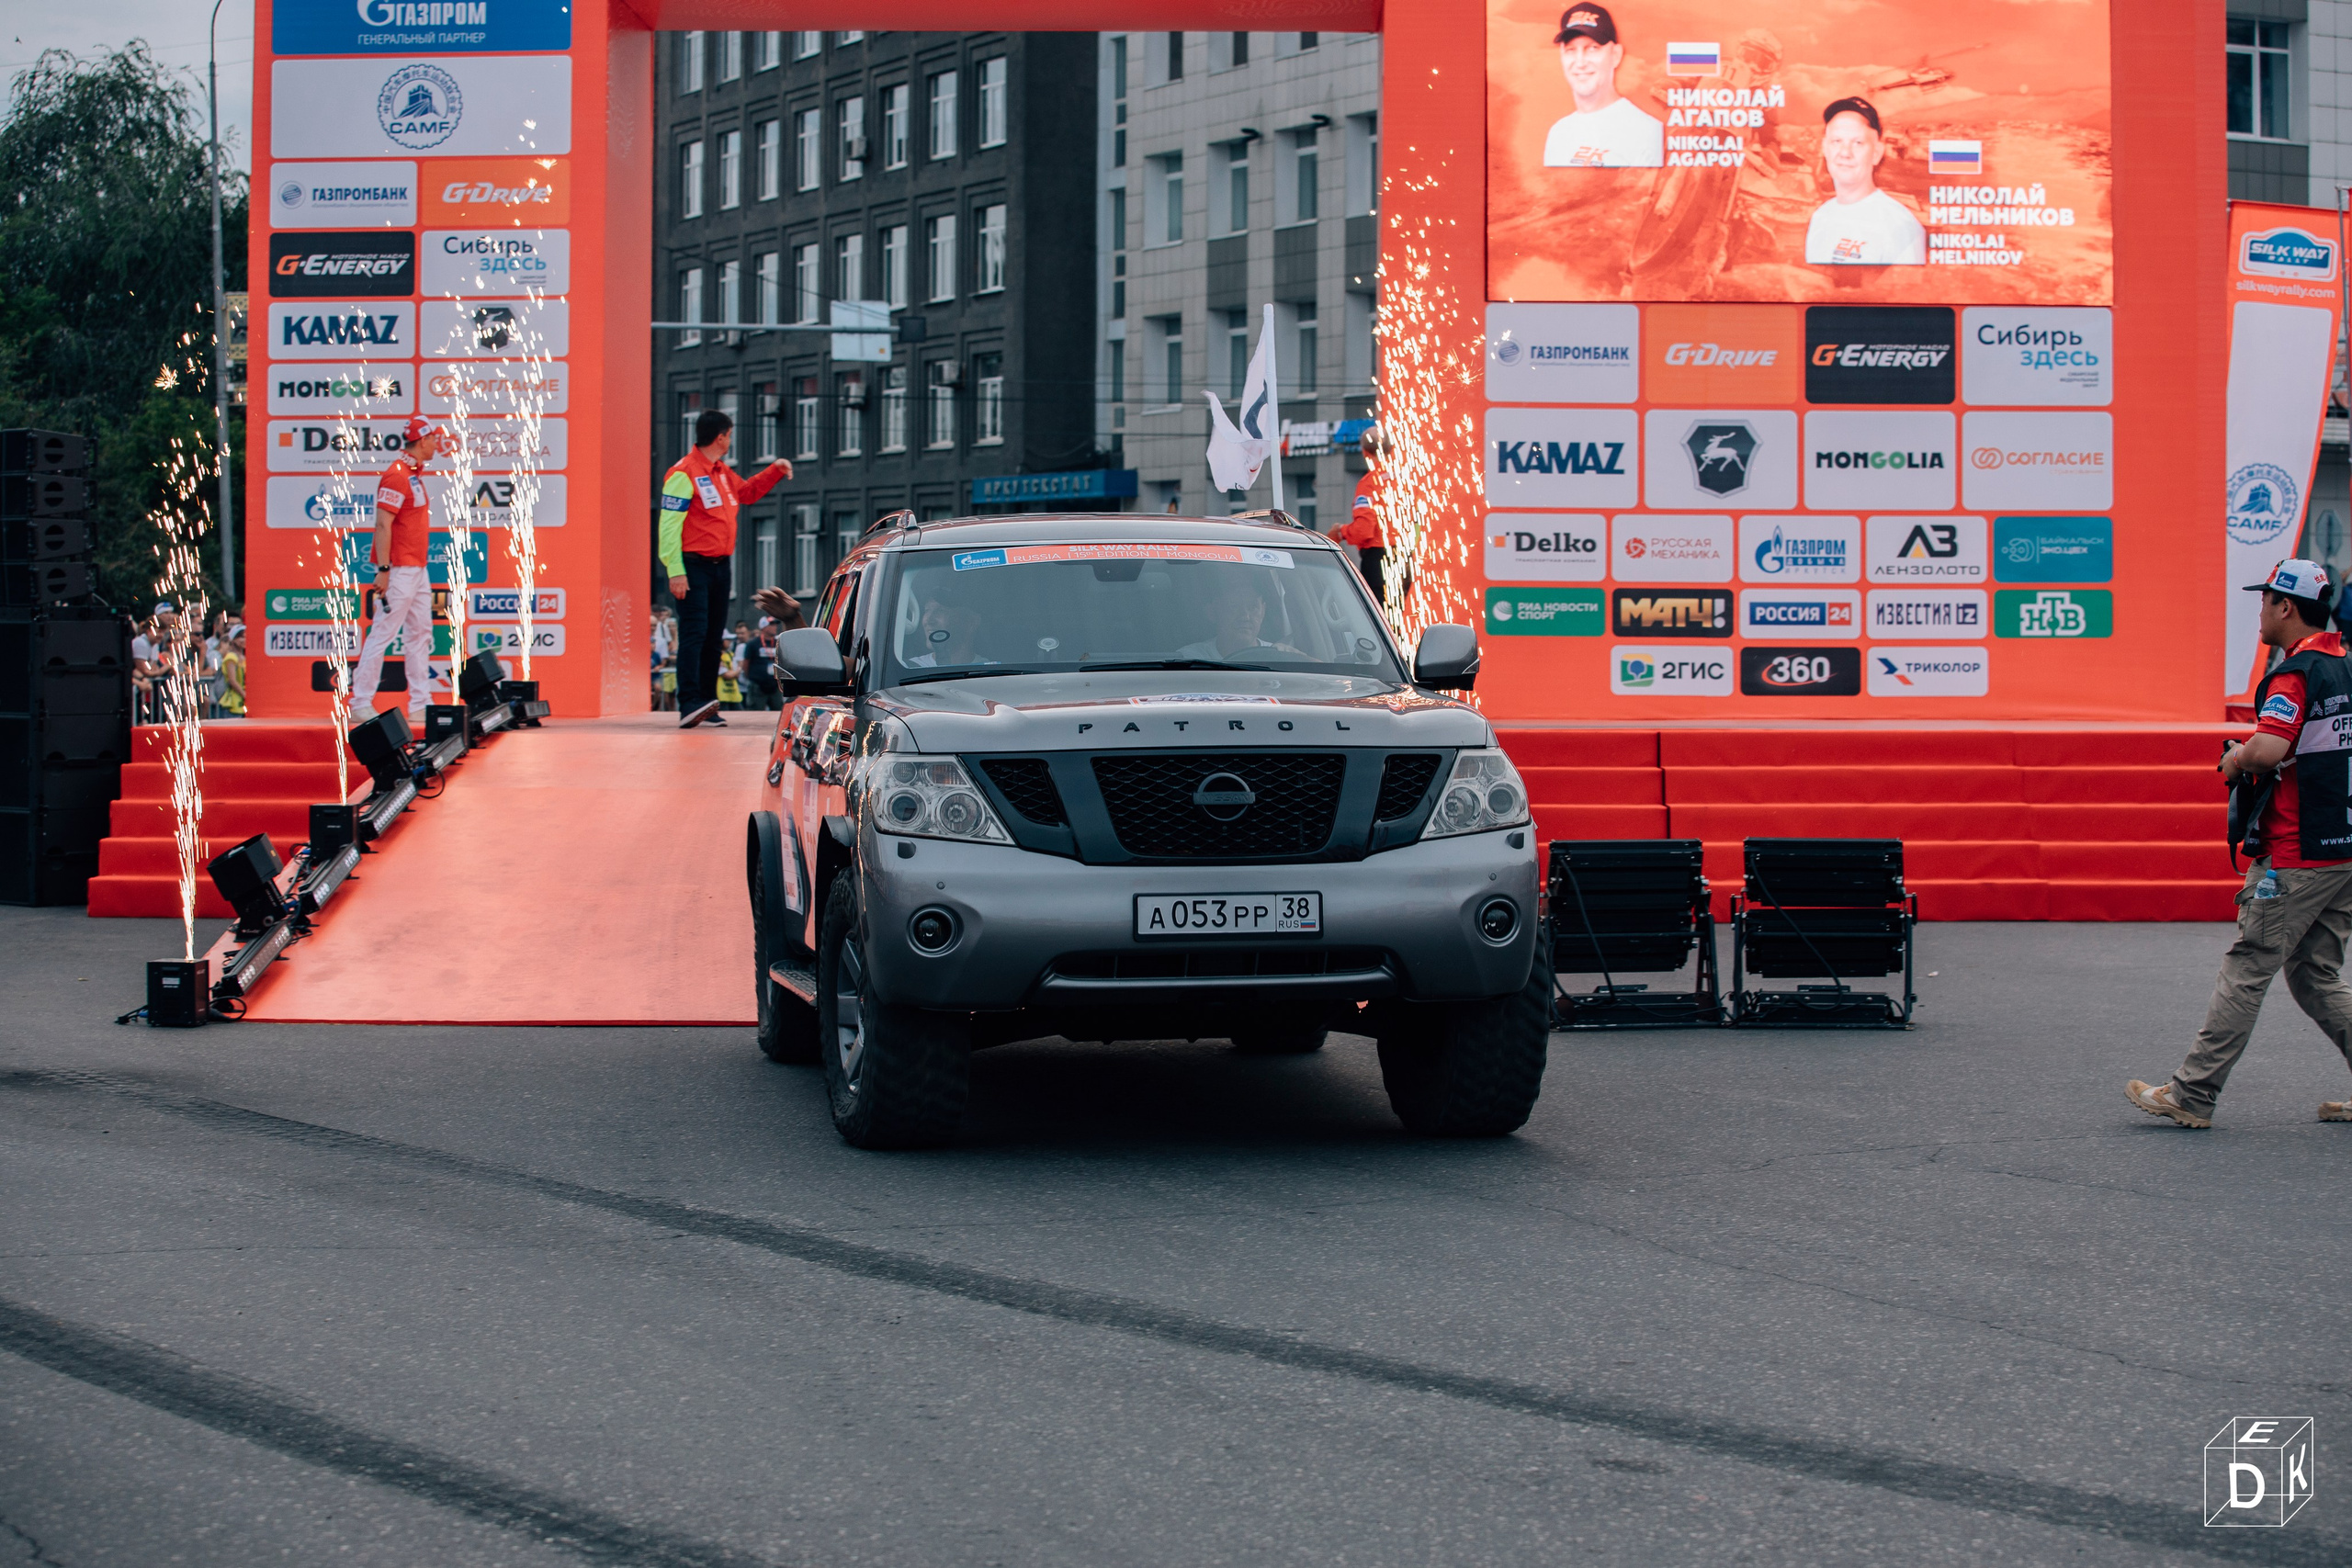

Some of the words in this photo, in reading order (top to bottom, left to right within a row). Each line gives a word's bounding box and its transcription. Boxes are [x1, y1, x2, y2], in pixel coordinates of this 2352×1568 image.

[396, 2, 487, 26] ГАЗПРОМ
[357, 32, 436, 45] ГЕНЕРАЛЬНЫЙ
[438, 32, 487, 44] ПАРТНЕР
[1667, 85, 1785, 108] НИКОЛАЙ
[1667, 108, 1765, 128] АГАПОВ
[390, 121, 450, 134] CAMF
[1667, 135, 1743, 152] NIKOLAI
[1667, 152, 1745, 167] AGAPOV
[312, 186, 408, 201] ГАЗПРОМБАНК
[1929, 183, 2045, 206] НИКОЛАЙ
[1929, 207, 2075, 227] МЕЛЬНИКОВ
[444, 236, 533, 258] Сибирь
[1929, 233, 2005, 249] NIKOLAI
[1929, 249, 2023, 265] MELNIKOV
[2249, 243, 2290, 256] SILK
[2292, 247, 2329, 260] WAY
[480, 257, 547, 275] здесь
[2235, 279, 2335, 299] silkwayrally.com
[283, 315, 400, 345] KAMAZ
[1977, 323, 2083, 351] Сибирь
[1530, 345, 1630, 360] ГАЗПРОМБАНК
[2020, 350, 2099, 370] здесь
[278, 380, 402, 398] MONGOLA
[462, 378, 560, 393] СОГЛАСИЕ
[467, 432, 539, 443] РУССК
[1498, 441, 1625, 475] KAMAZ
[1815, 451, 1945, 469] MONGOLIA
[2006, 451, 2105, 466] СОГЛАСИЕ
[2226, 515, 2282, 531] CAMF
[1514, 532, 1597, 553] Delko
[1651, 537, 1712, 548] РУССКАЯ
[1785, 539, 1846, 555] ГАЗПРОМ
[1012, 553, 1061, 563] RUSSIA
[1167, 551, 1238, 561] MONGOLIA
[1651, 549, 1721, 559] МЕХАНИКА
[1874, 566, 1980, 575] ЛЕНЗОЛОТО
[540, 597, 557, 610] 24
[1517, 602, 1542, 612] РИА
[1544, 603, 1599, 613] НОВОСТИ
[1517, 611, 1555, 620] СПОРТ
[1620, 598, 1726, 628] МАТЧ!
[1755, 606, 1820, 621] РОССИЯ
[1829, 606, 1850, 621] 24
[1876, 603, 1951, 626] ИЗВЕСТИЯ
[2021, 592, 2085, 635] НТВ
[271, 631, 333, 649] ИЗВЕСТИЯ
[508, 633, 555, 647] 2ИС
[1662, 662, 1724, 680] 2ГИС
[1771, 656, 1831, 683] 360
[1905, 663, 1981, 673] ТРИКОЛОР
[2277, 703, 2294, 713] WAY
[1078, 719, 1351, 734] PATROL
[1282, 897, 1310, 919] 38
[1278, 919, 1300, 930] RUS
